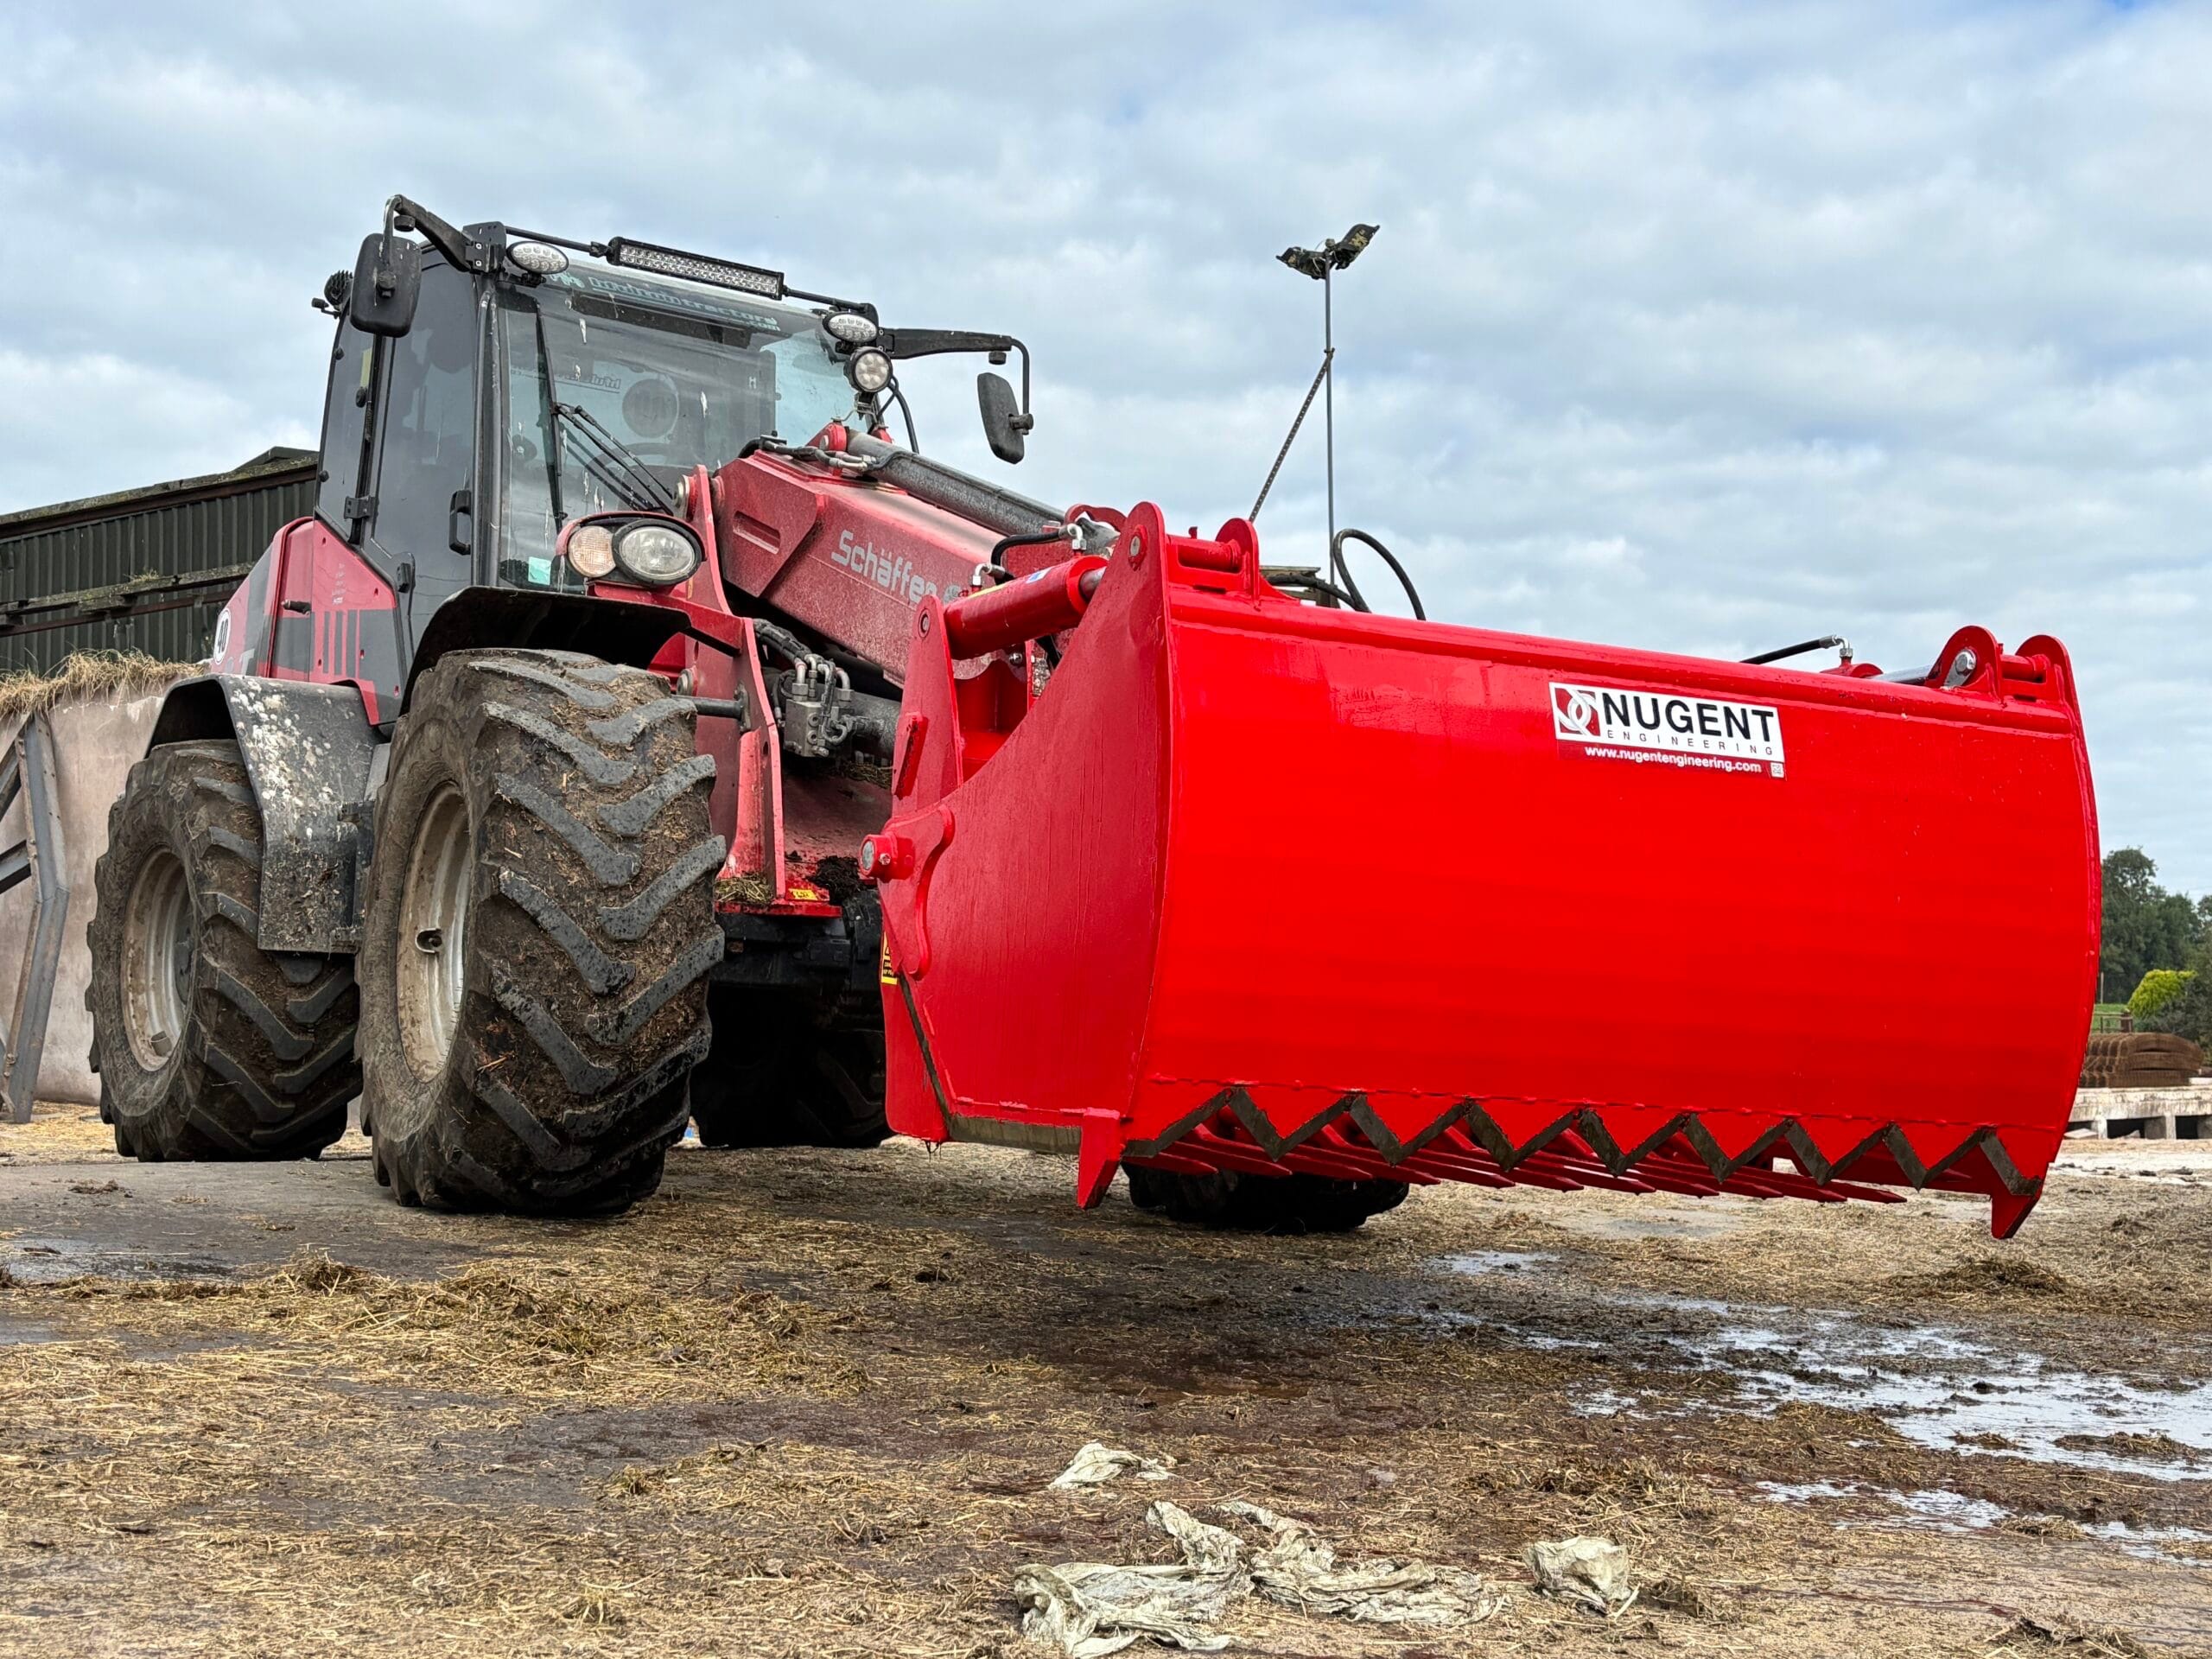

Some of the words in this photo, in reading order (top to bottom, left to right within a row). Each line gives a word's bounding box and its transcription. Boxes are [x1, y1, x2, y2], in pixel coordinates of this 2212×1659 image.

[1602, 692, 1774, 742] NUGENT
[1607, 729, 1773, 755] ENGINEERING
[1585, 746, 1762, 772] www.nugentengineering.com
